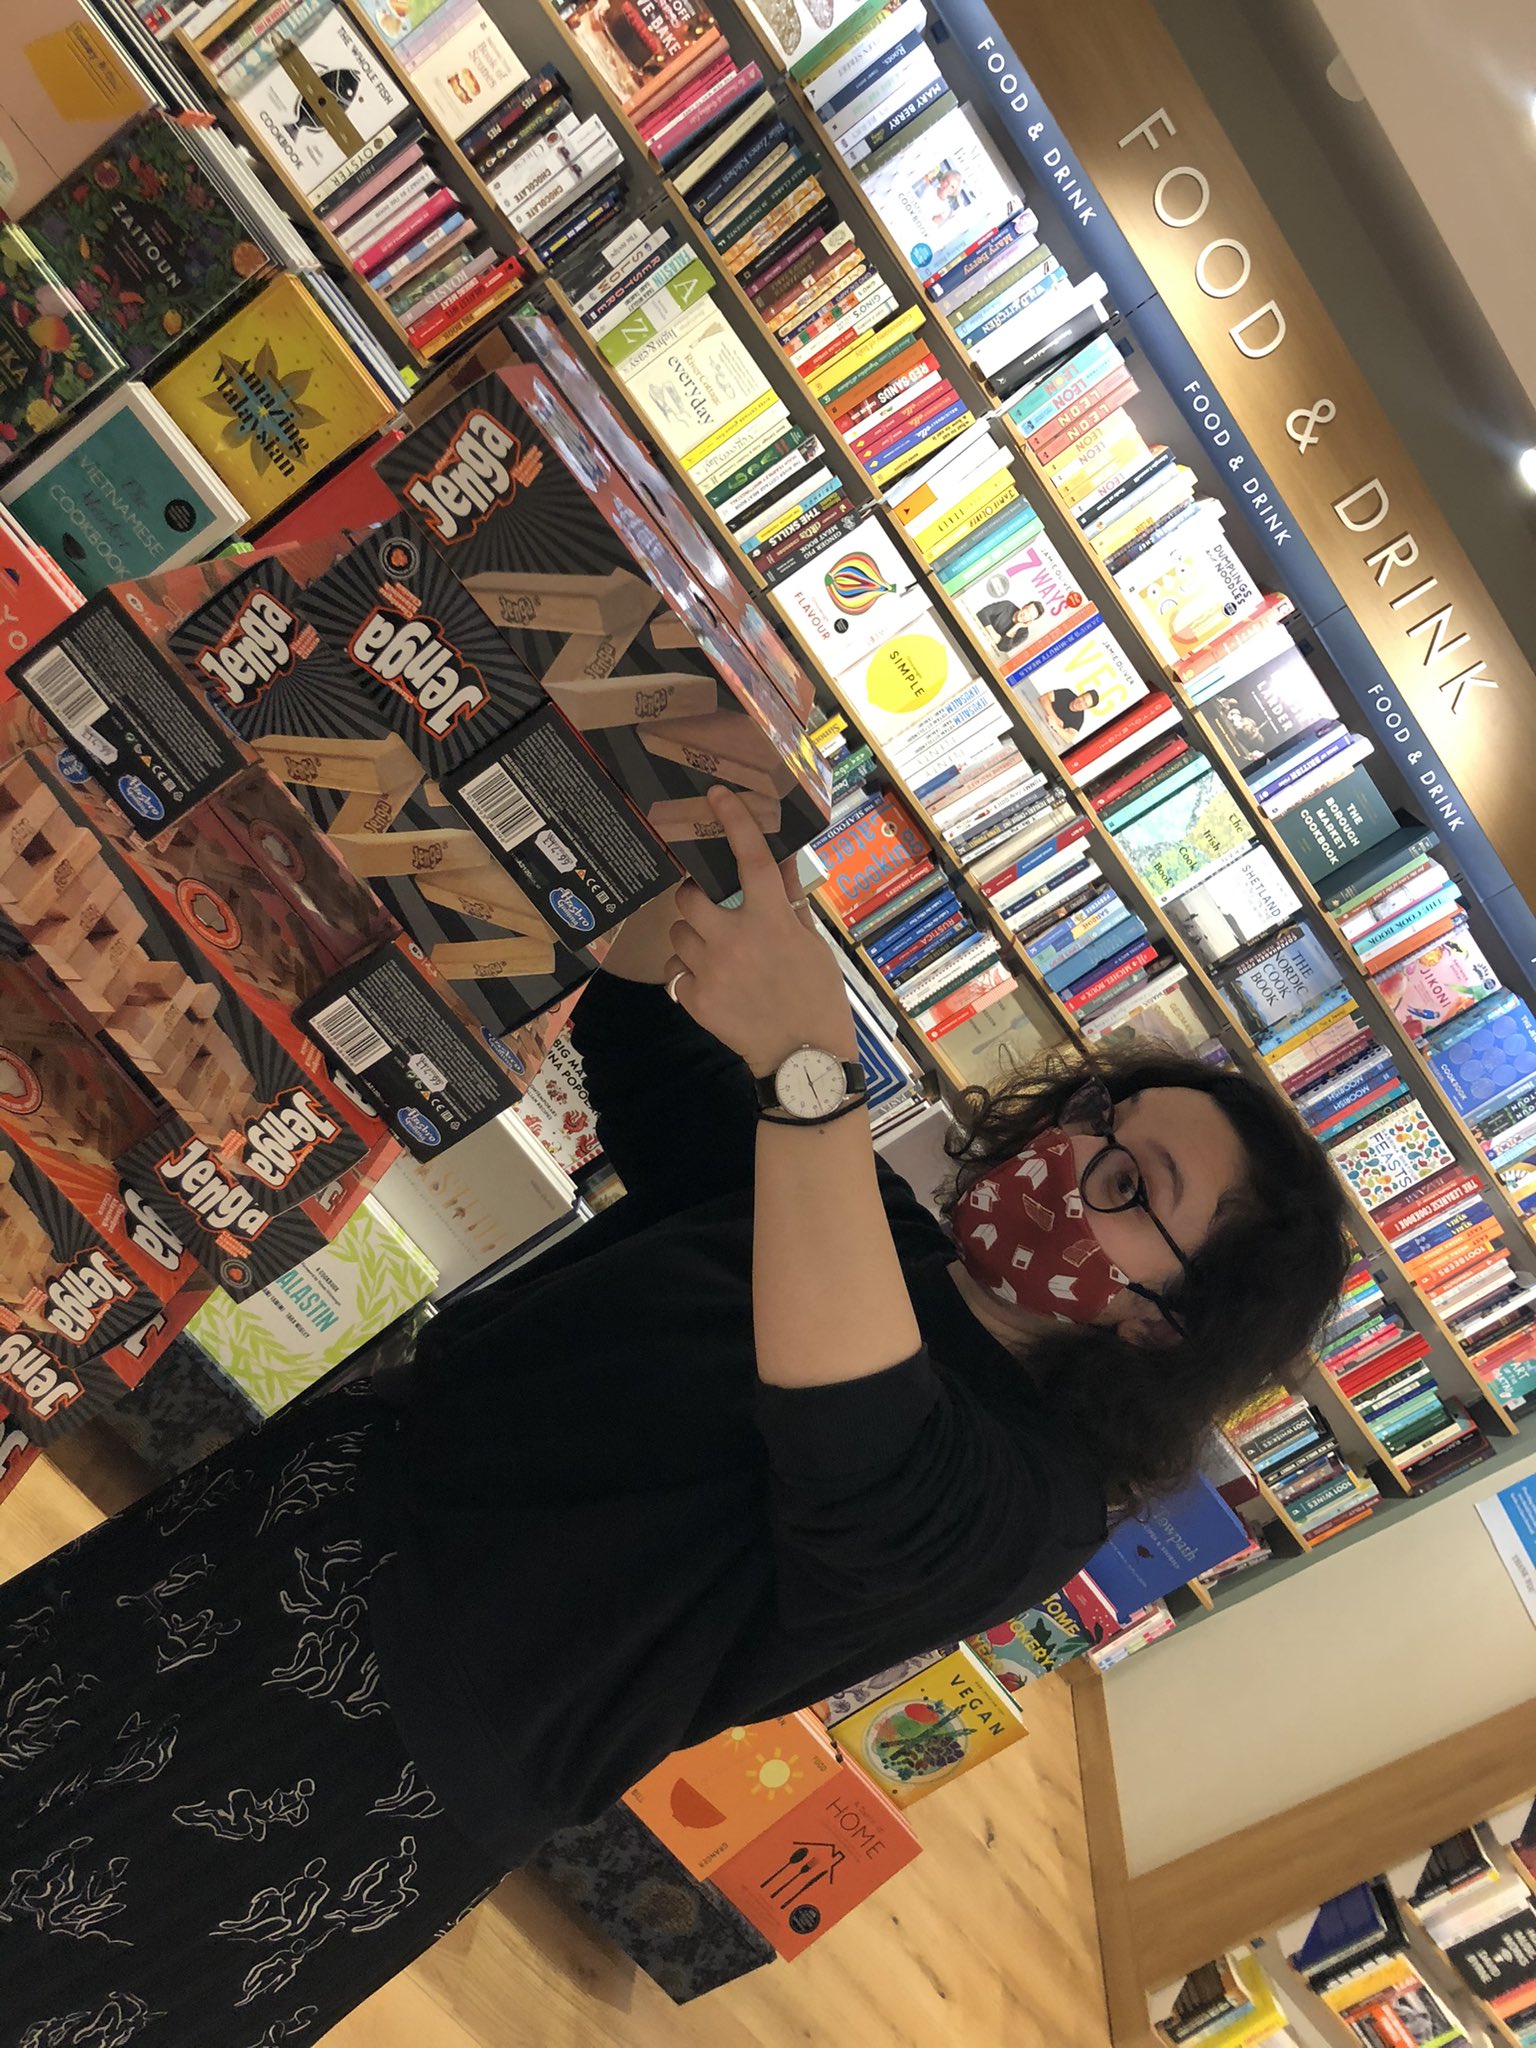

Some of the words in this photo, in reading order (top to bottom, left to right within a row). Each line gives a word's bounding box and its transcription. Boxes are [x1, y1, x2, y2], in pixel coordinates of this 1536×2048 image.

[649, 16, 681, 56] BAKE
[336, 27, 353, 47] THE
[349, 45, 378, 83] WHOLE
[374, 82, 393, 105] FISH
[467, 49, 497, 89] Scones
[521, 95, 537, 110] PIES
[913, 84, 942, 108] MARY
[886, 103, 916, 130] BERRY
[258, 110, 304, 171] COOKBOOK
[486, 125, 501, 139] PIES
[767, 123, 786, 141] Blue
[974, 37, 1031, 115] FOOD
[1025, 121, 1047, 143] &
[1040, 148, 1098, 228] DRINK
[746, 137, 770, 160] Zones
[329, 148, 374, 186] OYSTER
[354, 165, 376, 184] FRUIT
[720, 156, 750, 184] Kitchen
[513, 168, 551, 202] CHOCOLATE
[525, 185, 563, 219] CHOCOLATE
[110, 201, 182, 290] ZAITOUN
[989, 234, 1014, 256] Mary
[595, 250, 645, 295] SLOW
[650, 250, 691, 287] FALASTIN
[961, 251, 990, 277] Berry
[423, 271, 468, 307] ROASTS
[594, 256, 662, 315] RESTORE
[674, 274, 703, 303] A
[439, 293, 459, 311] MEAT
[852, 294, 881, 319] GINO'S
[442, 323, 463, 341] BOOK
[619, 316, 650, 345] Z
[907, 363, 929, 383] RED
[1042, 365, 1078, 396] LEON
[876, 376, 911, 404] SANDS
[1051, 379, 1087, 410] LEON
[205, 362, 298, 480] Malaysian
[232, 356, 314, 459] Amazing
[1056, 390, 1100, 426] LEON
[1065, 404, 1109, 440] LEON
[1116, 111, 1294, 363] FOOD
[1281, 393, 1345, 453] &
[1332, 479, 1498, 712] DRINK
[1074, 429, 1102, 452] LEON
[1078, 442, 1106, 465] LEON
[408, 415, 514, 538] Jenga
[1181, 380, 1232, 449] FOOD
[1226, 454, 1245, 472] &
[1240, 477, 1291, 548] DRINK
[992, 490, 1015, 510] JAMIE
[1097, 474, 1125, 497] LEON
[78, 454, 163, 558] VIETNAMESE
[798, 507, 819, 525] THE
[967, 506, 993, 528] OLIVER
[48, 482, 129, 580] COOKBOOK
[767, 520, 800, 547] SKILLS
[799, 537, 821, 554] BOOK
[819, 530, 842, 549] GINGER
[820, 525, 838, 539] MEAT
[803, 546, 820, 561] PIG
[1040, 548, 1057, 569] JAMIE
[1003, 548, 1041, 582] 7
[1029, 570, 1069, 617] WAYS
[1212, 544, 1252, 599] DUMPLINGS
[1214, 563, 1245, 606] NOODLES
[500, 596, 534, 624] Jenga
[793, 591, 831, 641] FLAVOUR
[201, 594, 292, 703] Jenga
[584, 639, 616, 679] Jenga
[1102, 640, 1118, 661] JAMIE
[1115, 661, 1135, 686] OLIVER
[353, 614, 483, 734] Jenga
[888, 650, 925, 698] SIMPLE
[1060, 642, 1128, 717] VEG
[635, 688, 667, 718] Jenga
[944, 685, 981, 714] JERUSALEM
[952, 697, 988, 726] JERUSALEM
[1255, 681, 1294, 732] LARDER
[1097, 703, 1163, 750] OTTOLENGHI
[1366, 683, 1412, 746] FOOD
[1405, 749, 1424, 766] &
[1418, 769, 1465, 833] DRINK
[364, 801, 391, 833] Jenga
[863, 803, 874, 813] THE
[1323, 797, 1360, 848] BOROUGH
[1344, 803, 1363, 826] THE
[814, 802, 903, 870] Latera
[826, 809, 865, 839] SEAFOOD
[1226, 813, 1245, 834] The
[1298, 809, 1339, 866] COOKBOOK
[1314, 808, 1347, 852] MARKET
[1201, 829, 1221, 852] Irish
[413, 843, 442, 869] Jenga
[834, 829, 925, 901] Cooking
[1176, 845, 1198, 871] Cook
[1152, 861, 1174, 887] Book
[1241, 863, 1282, 918] SHETLAND
[556, 898, 579, 927] Gaming
[559, 890, 592, 929] Hasbro
[1081, 909, 1109, 930] SARDINE
[1393, 909, 1422, 931] COOK
[919, 918, 955, 946] RUSTICA
[1367, 926, 1394, 947] BOOK
[1106, 963, 1132, 984] MICHEL
[1272, 950, 1307, 995] NORDIC
[1290, 951, 1313, 979] THE
[1086, 982, 1105, 998] ROUX
[1249, 971, 1279, 1007] BOOK
[1261, 962, 1292, 1000] COOK
[1418, 967, 1452, 1008] JIKONI
[552, 1038, 570, 1059] BIG
[1327, 1075, 1363, 1101] MOORISH
[1439, 1063, 1468, 1101] COOKBOOK
[530, 1085, 557, 1118] ONTEMPORARY
[536, 1102, 552, 1121] RECIPES
[1332, 1085, 1369, 1111] MOORISH
[247, 1092, 336, 1185] Jenga
[406, 1108, 438, 1144] Hasbro
[1368, 1132, 1412, 1189] FEASTS
[161, 1140, 269, 1236] Jenga
[1429, 1187, 1463, 1212] LEBANESE
[1461, 1179, 1477, 1193] THE
[1397, 1206, 1431, 1230] COOKBOOK
[1465, 1225, 1482, 1238] EAST
[1471, 1234, 1488, 1246] EAST
[318, 1270, 338, 1293] COOKBOOK
[48, 1252, 132, 1341] Jenga
[277, 1269, 337, 1333] ALASTIN
[0, 1333, 79, 1416] Jeng
[1291, 1418, 1309, 1432] 1001
[1306, 1491, 1333, 1510] WINES
[1332, 1480, 1351, 1495] 1001
[1347, 1504, 1365, 1517] FOLLY
[1365, 1497, 1378, 1508] WINE
[1510, 1554, 1529, 1579] THANK
[1006, 1615, 1054, 1670] OKERY
[948, 1674, 1004, 1738] VEGAN
[825, 1796, 885, 1860] HOME
